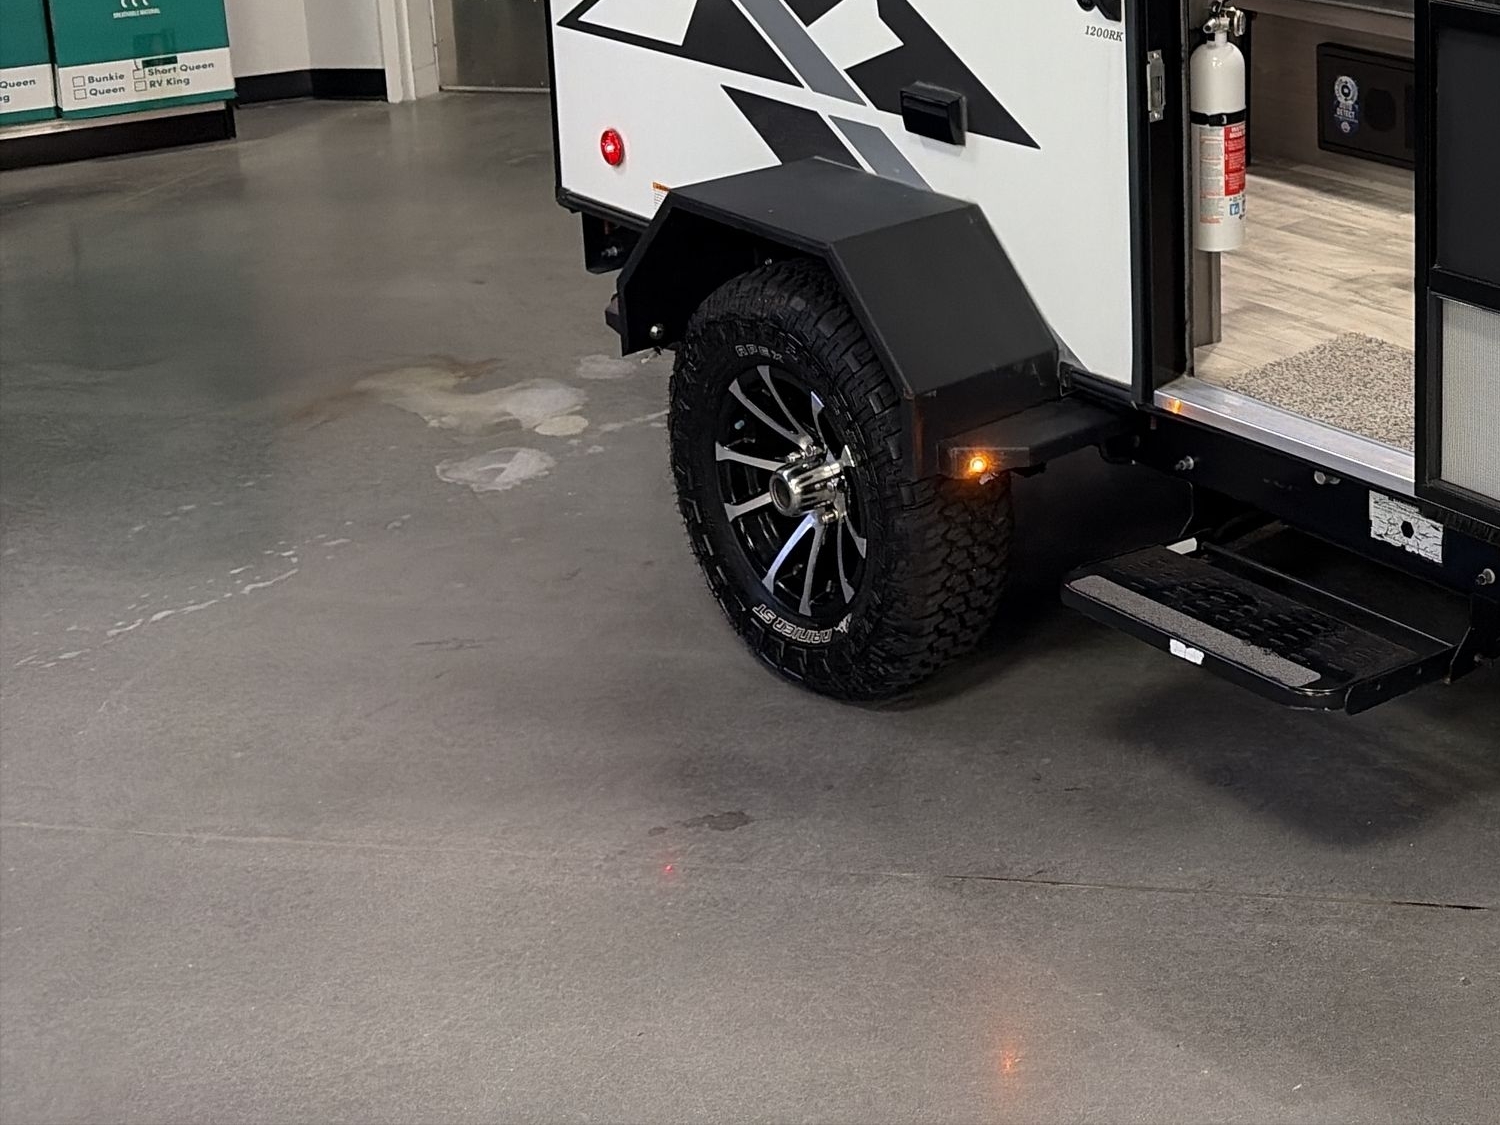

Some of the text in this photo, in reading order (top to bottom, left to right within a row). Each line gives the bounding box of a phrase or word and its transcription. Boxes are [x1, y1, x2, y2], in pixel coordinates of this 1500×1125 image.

[1085, 25, 1124, 42] 1200RK
[147, 61, 215, 76] Short Queen
[0, 79, 36, 88] Queen
[88, 73, 125, 84] Bunkie
[149, 76, 191, 88] RV King
[89, 86, 125, 96] Queen
[752, 603, 777, 624] ST
